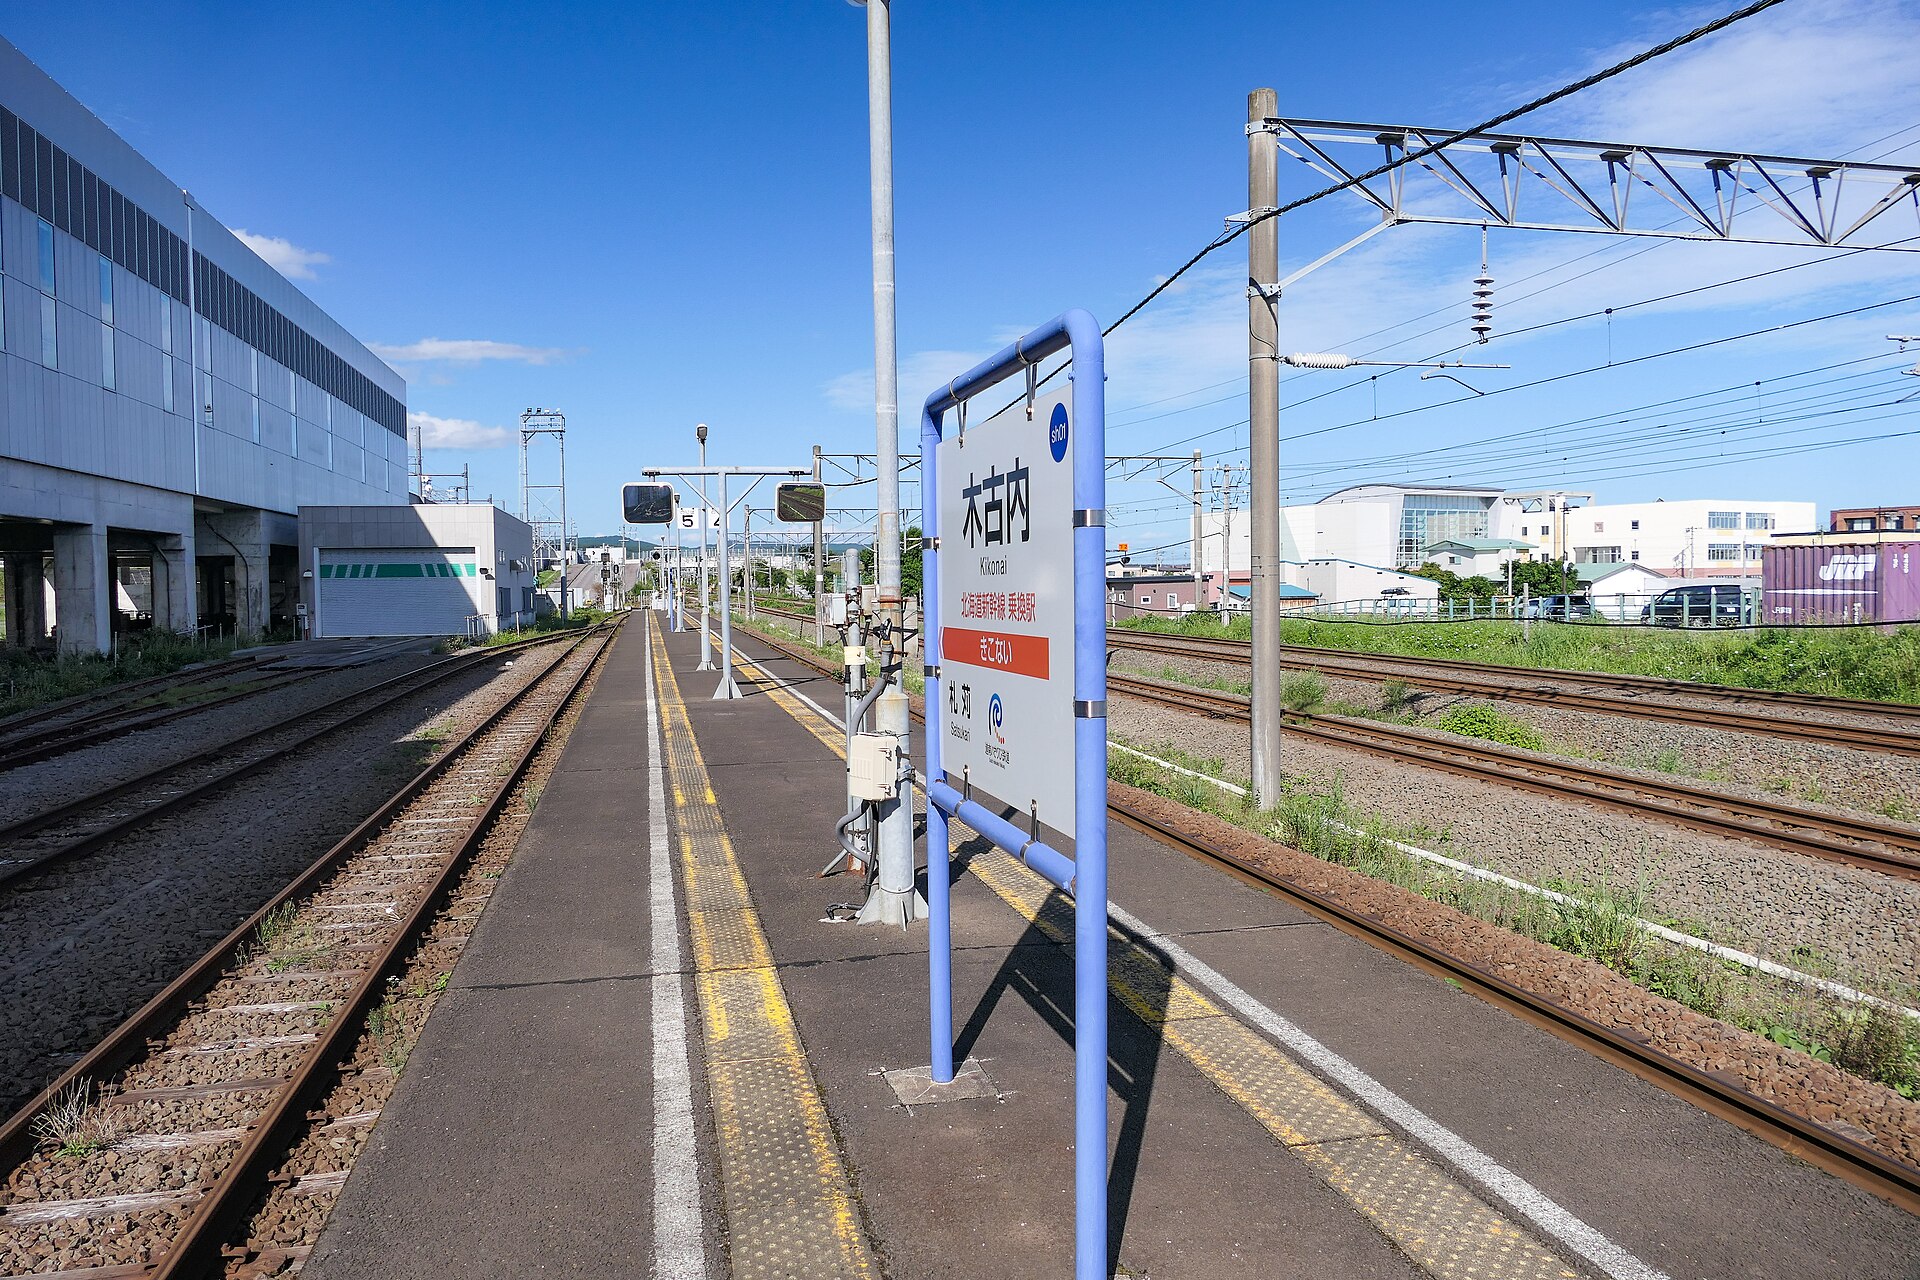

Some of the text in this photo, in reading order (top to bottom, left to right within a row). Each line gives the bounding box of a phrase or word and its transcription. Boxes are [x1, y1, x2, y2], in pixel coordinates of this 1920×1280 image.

[962, 457, 1029, 549] 木古内
[682, 514, 694, 528] 5
[980, 555, 1008, 576] Kikonai
[1818, 554, 1877, 581] JRF
[980, 636, 1013, 665] きこない
